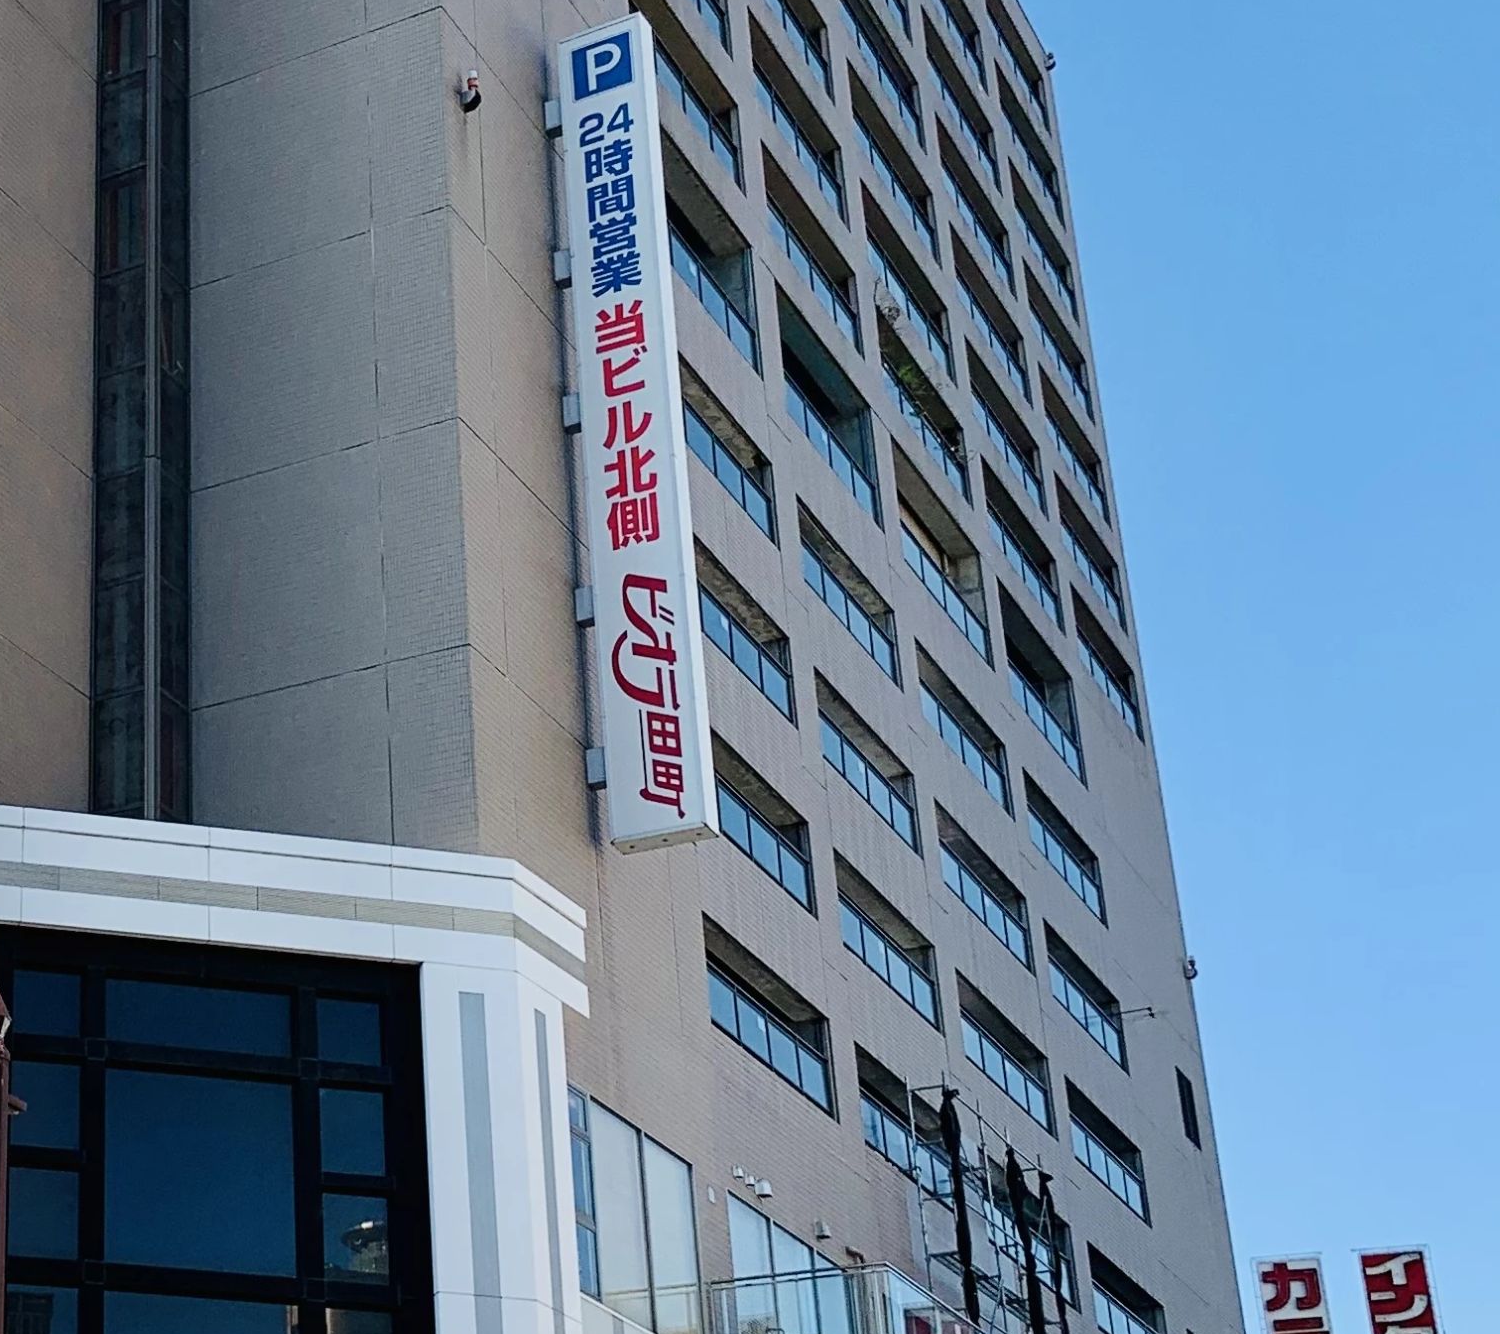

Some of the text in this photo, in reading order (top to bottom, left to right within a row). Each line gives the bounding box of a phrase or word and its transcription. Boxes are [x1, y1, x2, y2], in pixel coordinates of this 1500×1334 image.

[579, 104, 642, 299] 24時間営業
[594, 300, 661, 551] 当ビル北側
